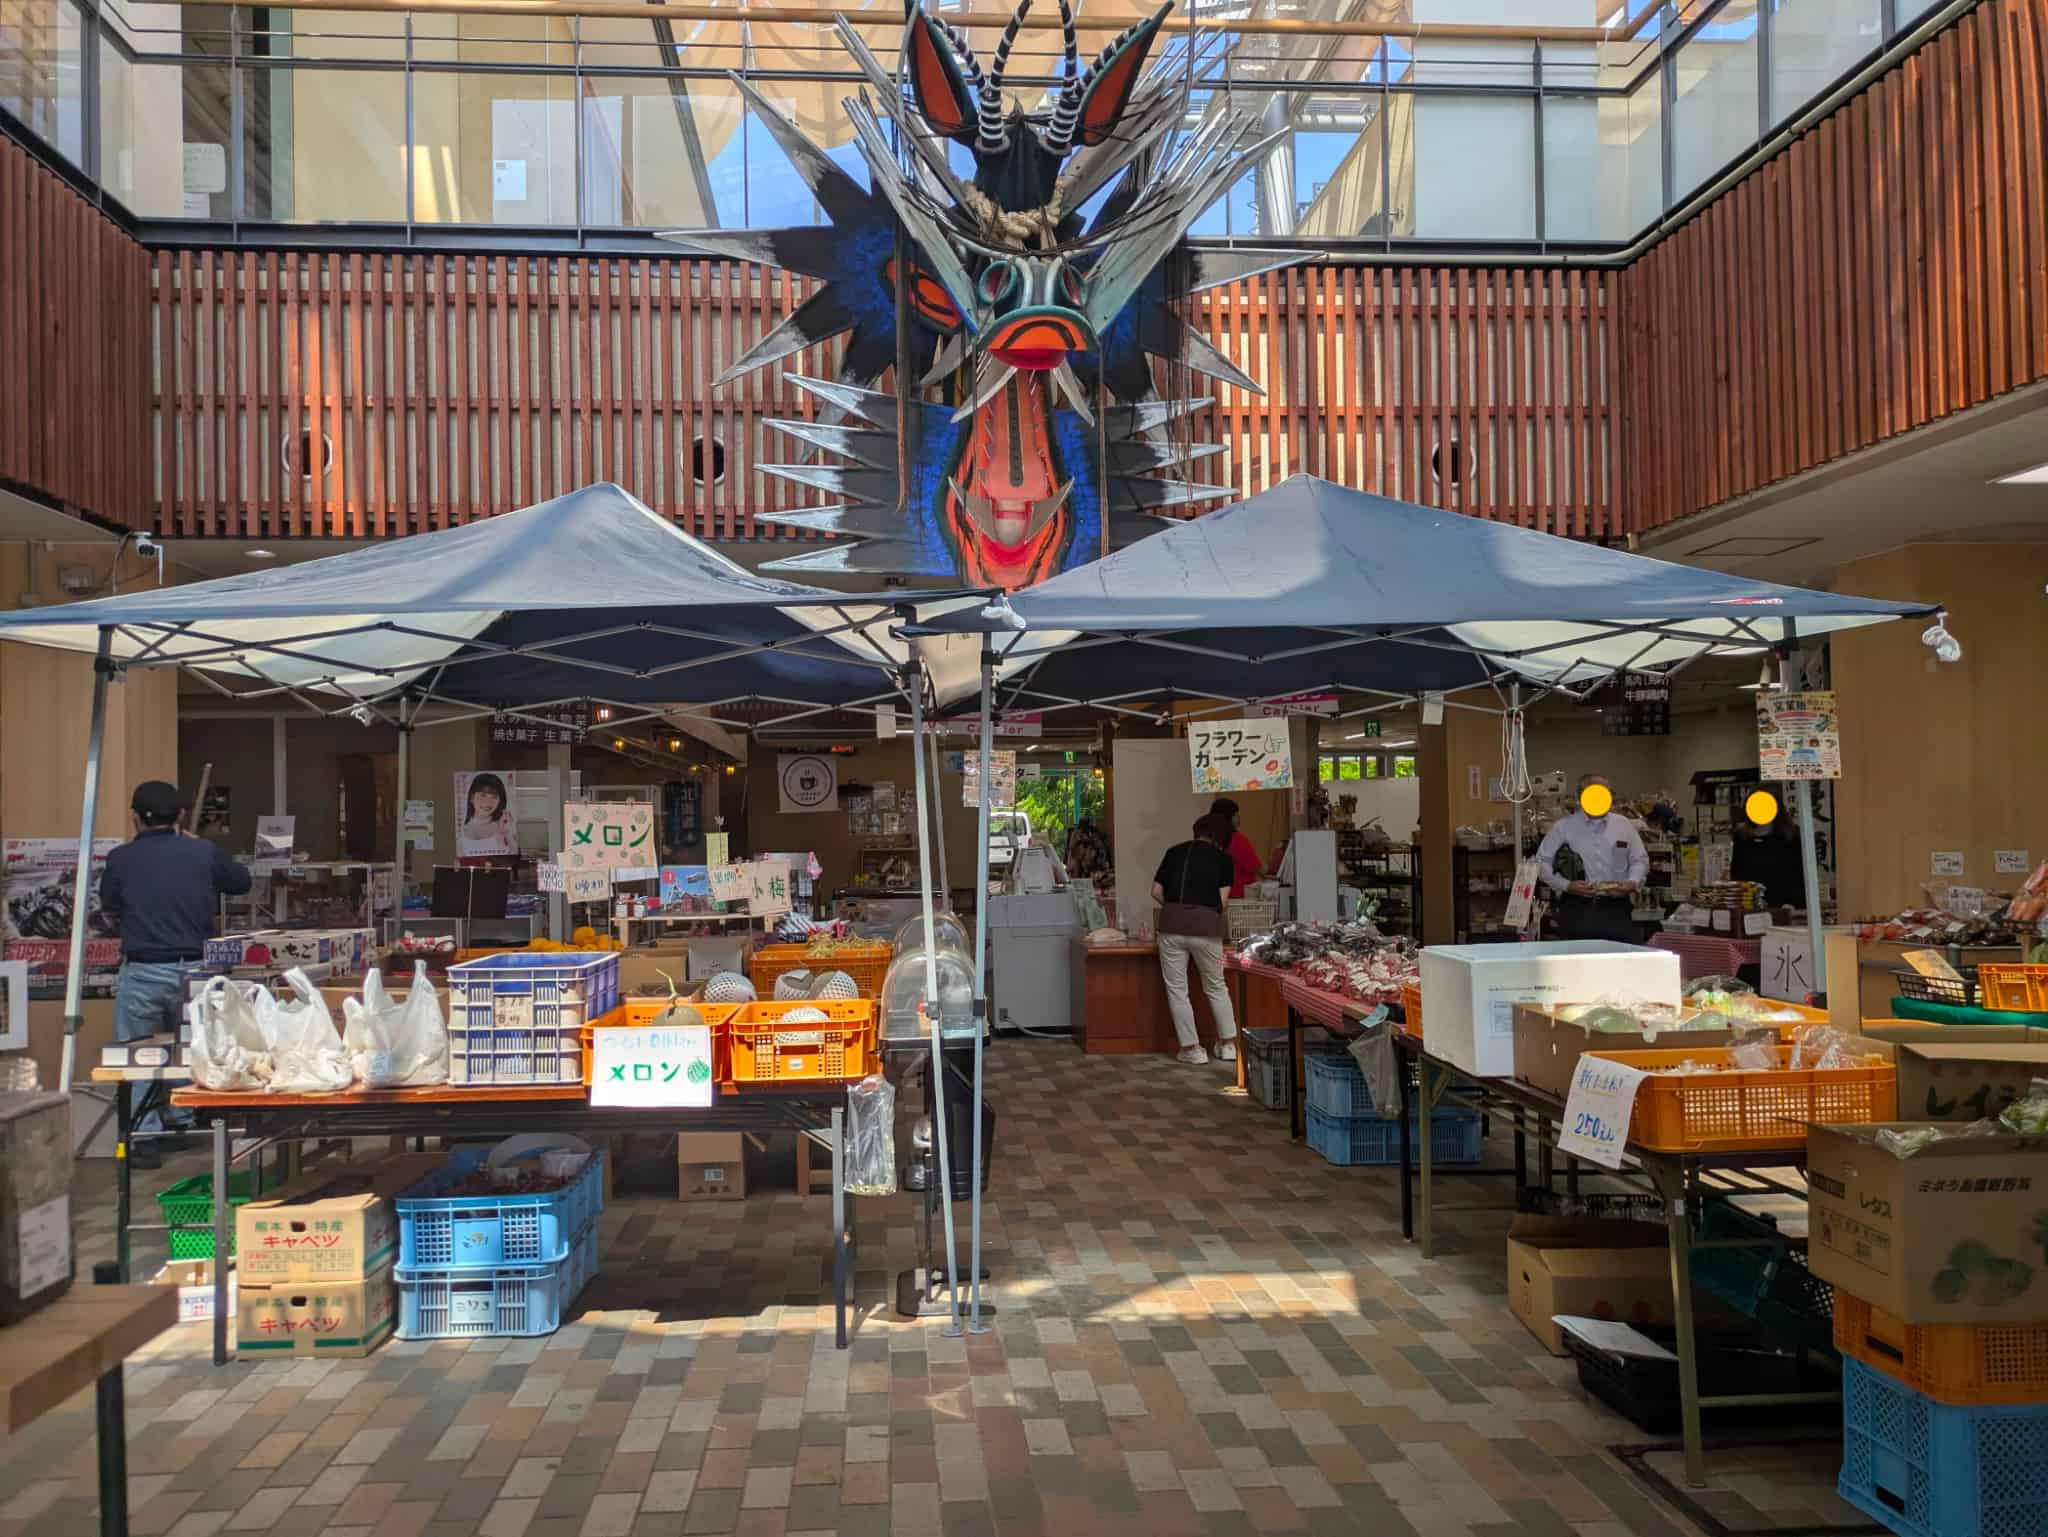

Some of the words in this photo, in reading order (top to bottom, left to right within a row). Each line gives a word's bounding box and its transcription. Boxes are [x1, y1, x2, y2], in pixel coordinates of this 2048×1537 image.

[1195, 730, 1262, 749] フラワー
[1195, 749, 1266, 768] ガーデン
[572, 822, 652, 848] メロン
[271, 941, 318, 960] いちご
[1773, 943, 1809, 992] 氷
[606, 1061, 681, 1083] メロン
[1859, 1192, 1892, 1219] レタス
[263, 1234, 342, 1248] キャベツ
[259, 1316, 342, 1334] キャベツ
